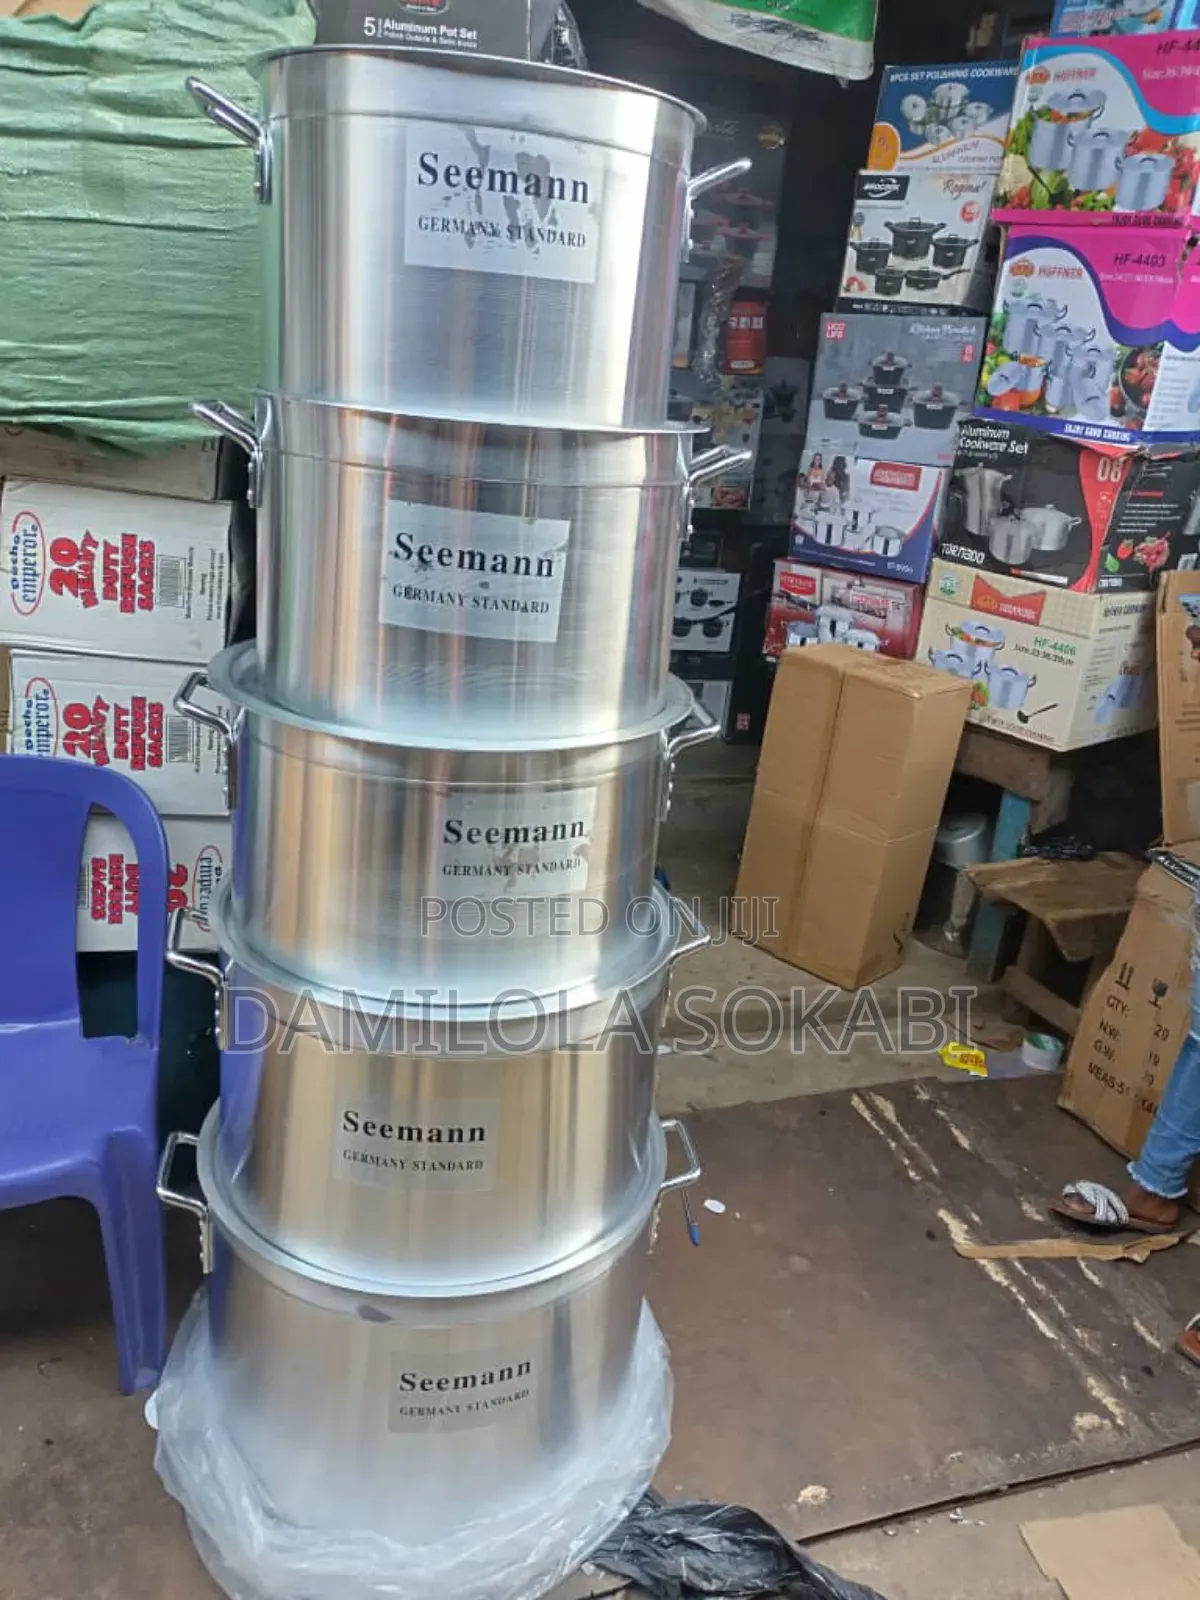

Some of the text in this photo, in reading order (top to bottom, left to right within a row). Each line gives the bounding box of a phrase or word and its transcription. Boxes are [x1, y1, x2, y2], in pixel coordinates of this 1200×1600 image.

[363, 16, 477, 40] 5 Aluminum Pot Set
[418, 151, 588, 203] Seemann
[418, 214, 586, 247] GERMANY STANDARD
[1114, 253, 1166, 268] HF-4403
[960, 438, 1028, 454] Cookware Set
[961, 425, 1010, 439] Aluminum
[1097, 457, 1121, 482] 08
[50, 537, 80, 597] 20
[78, 529, 99, 608] HEAVY
[103, 539, 119, 601] DUTY
[120, 532, 138, 614] REFUSE
[138, 540, 156, 612] SACKS
[394, 531, 554, 577] Seemann
[393, 584, 550, 613] GERMANY STANDARD
[35, 692, 50, 756] mperor
[63, 702, 91, 758] 20
[90, 695, 110, 766] HEAVY
[114, 703, 129, 759] DUTY
[131, 696, 146, 770] REFUSE
[148, 701, 163, 768] SACKS
[443, 818, 586, 845] Seemann
[91, 857, 107, 920] SACKS
[108, 854, 123, 924] REFUSE
[442, 857, 582, 877] GERMANY STANDARD
[1153, 1024, 1170, 1042] 20
[343, 1110, 486, 1143] Seemann
[343, 1150, 484, 1172] GERMANY STANDARD
[400, 1361, 531, 1391] Seemann
[400, 1389, 530, 1418] GERMANY STANDARD
